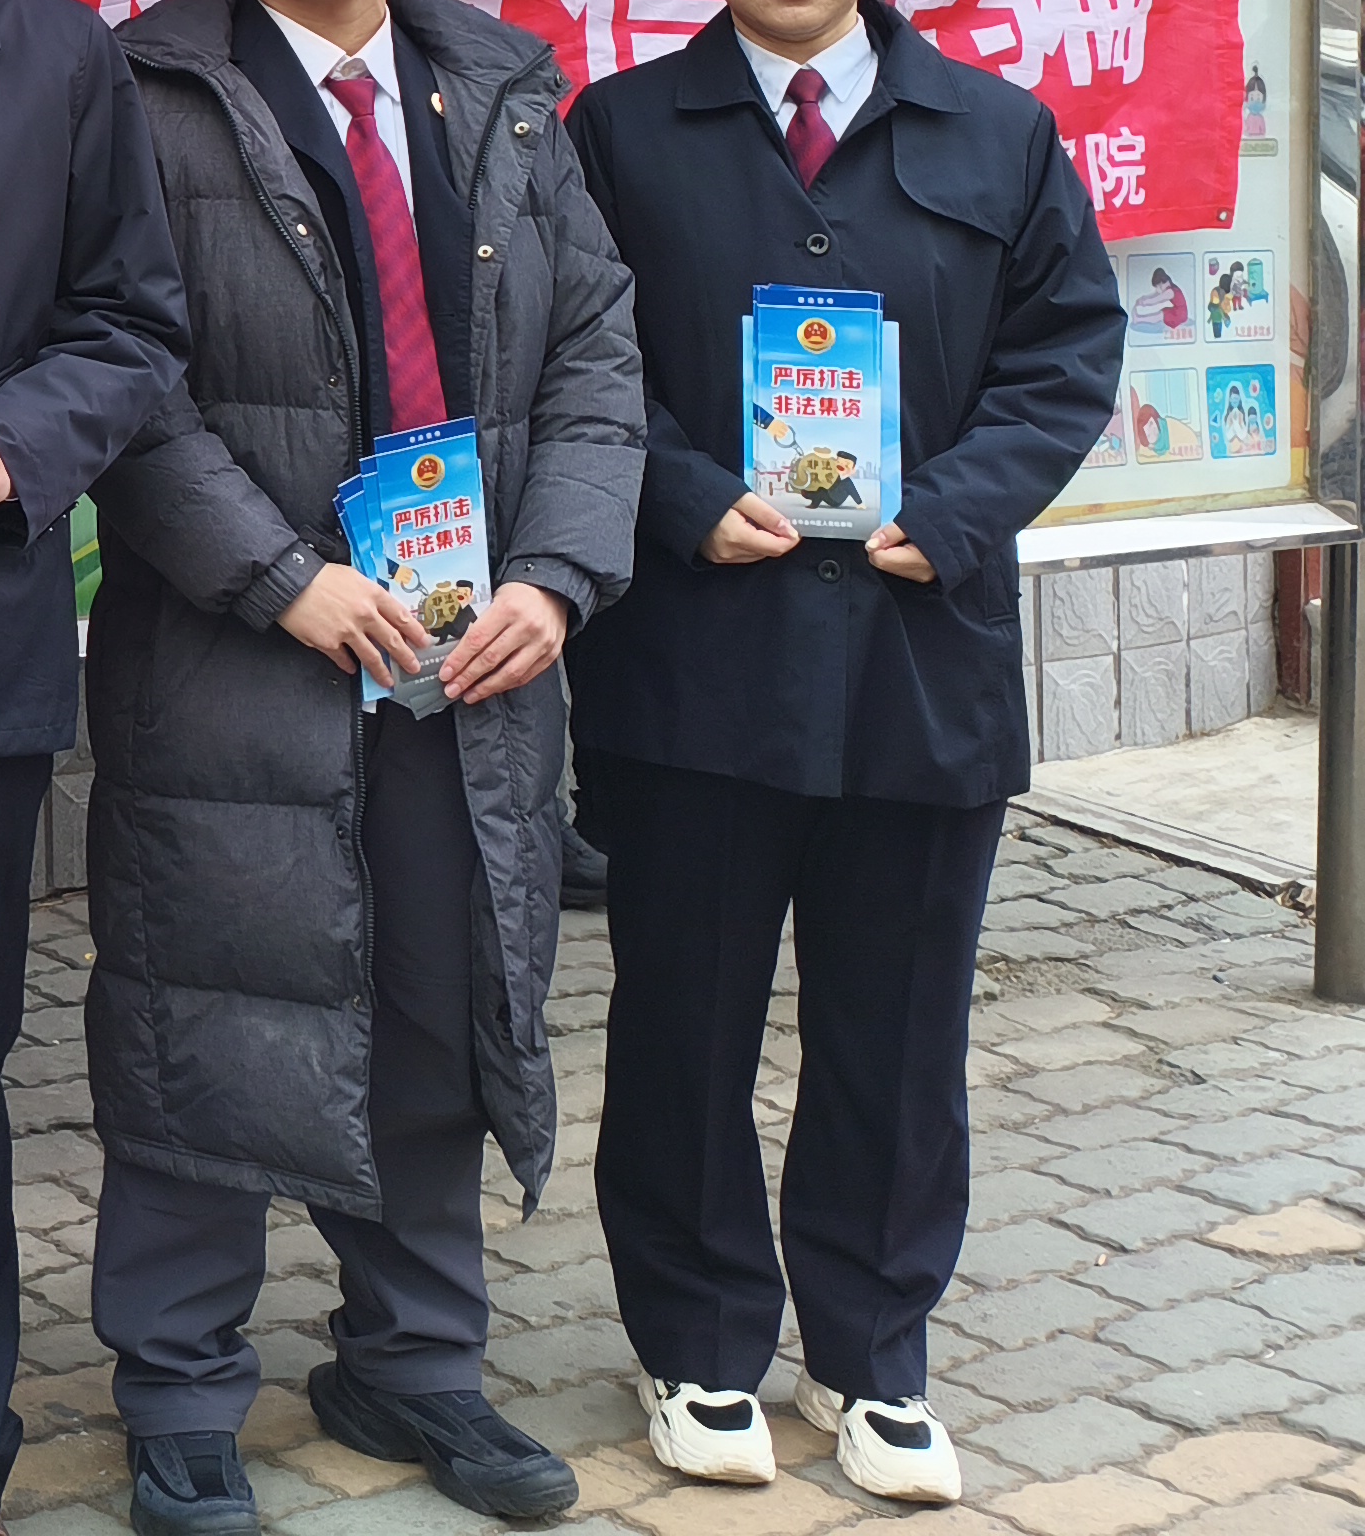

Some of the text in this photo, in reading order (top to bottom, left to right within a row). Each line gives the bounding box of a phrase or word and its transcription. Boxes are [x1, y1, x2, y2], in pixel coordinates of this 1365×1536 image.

[772, 366, 863, 390] 严厉打击
[772, 395, 862, 419] 非法集资
[393, 497, 472, 533] 严厉打击
[397, 525, 473, 560] 非法集资
